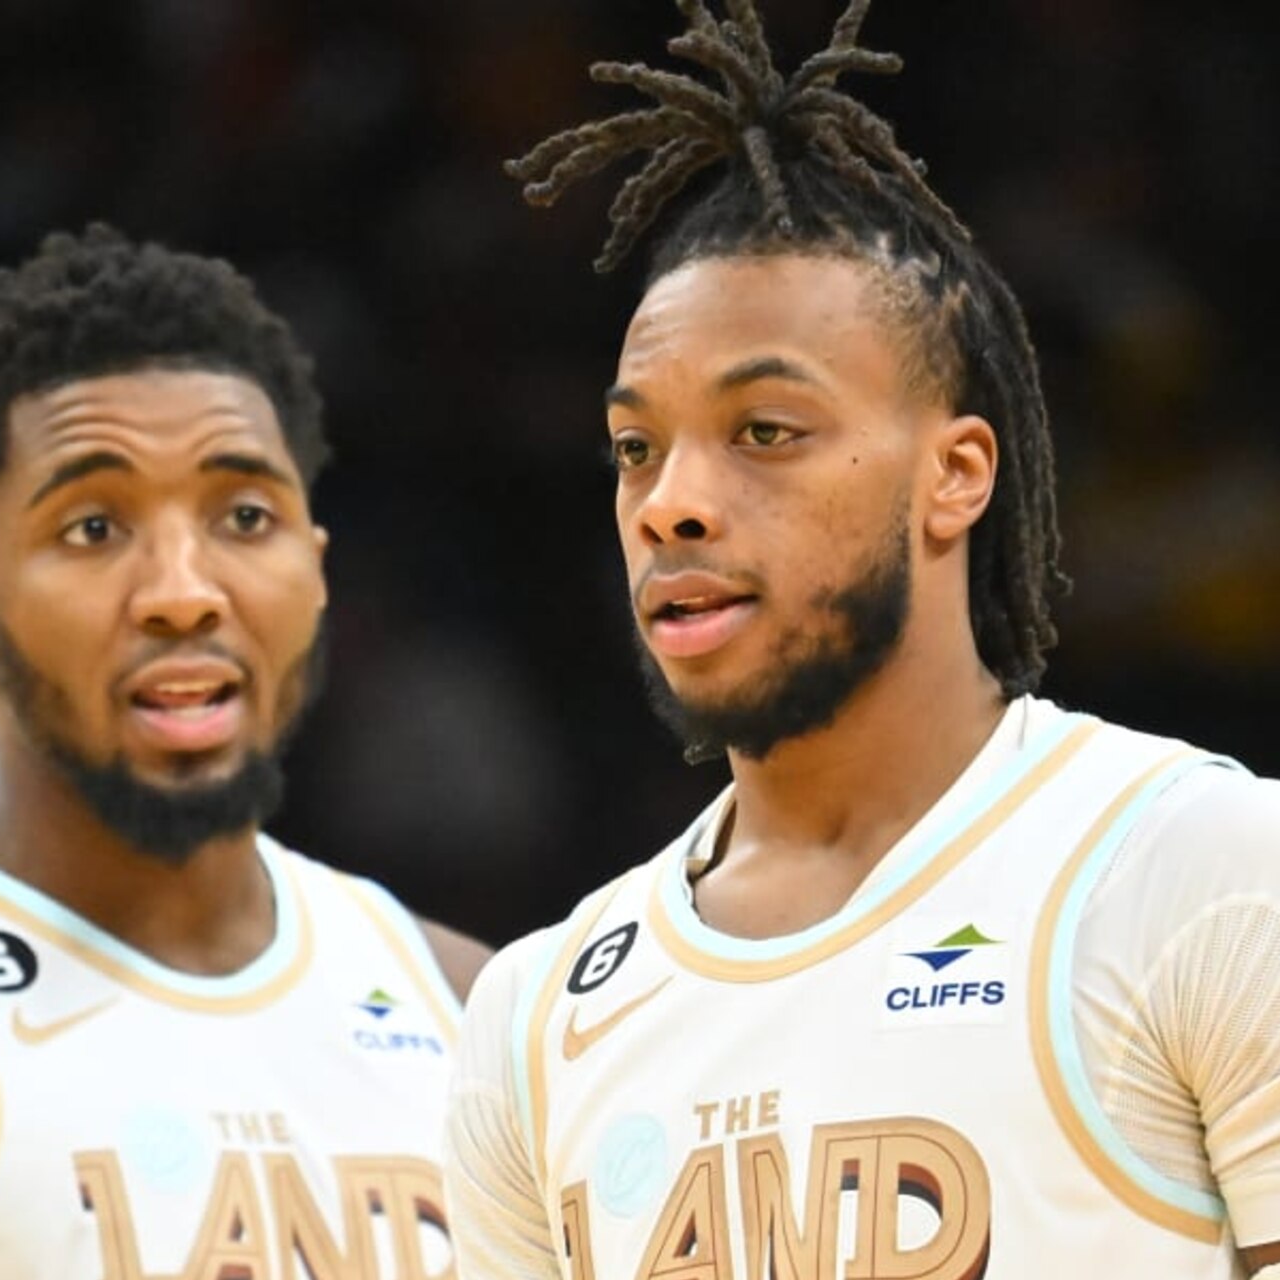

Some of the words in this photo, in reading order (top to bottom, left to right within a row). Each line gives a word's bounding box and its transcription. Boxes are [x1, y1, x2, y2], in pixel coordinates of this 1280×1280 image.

[885, 980, 1006, 1012] CLIFFS
[210, 1111, 290, 1144] THE
[693, 1090, 780, 1141] THE
